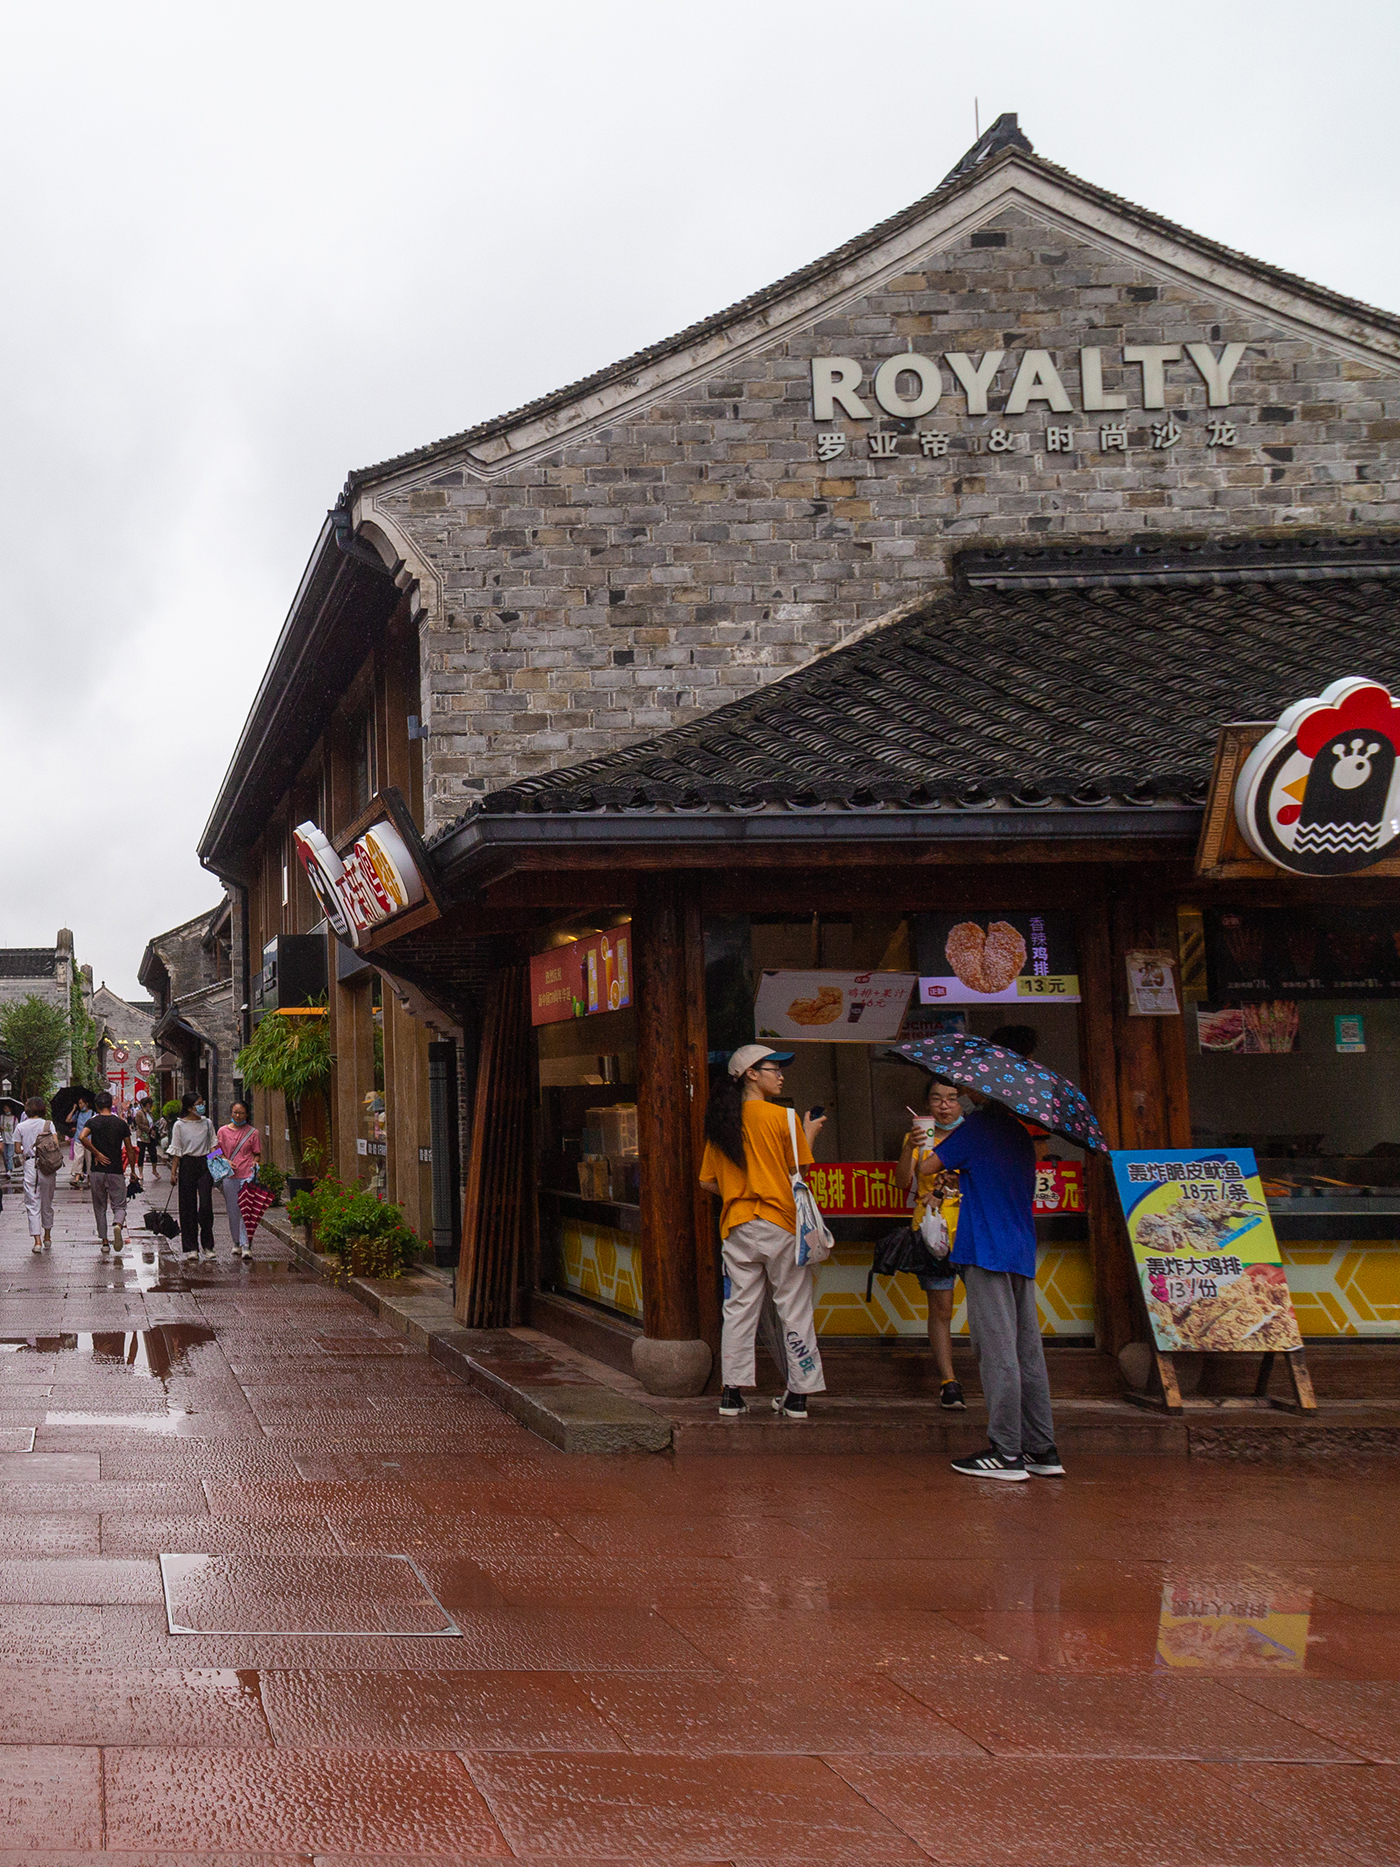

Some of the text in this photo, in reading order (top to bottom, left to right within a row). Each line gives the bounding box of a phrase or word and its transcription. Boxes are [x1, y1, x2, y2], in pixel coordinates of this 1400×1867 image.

[810, 342, 1248, 422] ROYALTY
[335, 835, 402, 931] 正新鸡排
[1029, 916, 1050, 977] 香辣鸡排
[1023, 978, 1067, 995] 13元
[804, 1168, 846, 1208] 鸡排
[1127, 1161, 1244, 1183] 轰炸脆皮鱿鱼
[1179, 1183, 1249, 1202] 18元/条
[1145, 1257, 1243, 1277] 轰炸大鸡排
[787, 1331, 817, 1376] CAN BE
